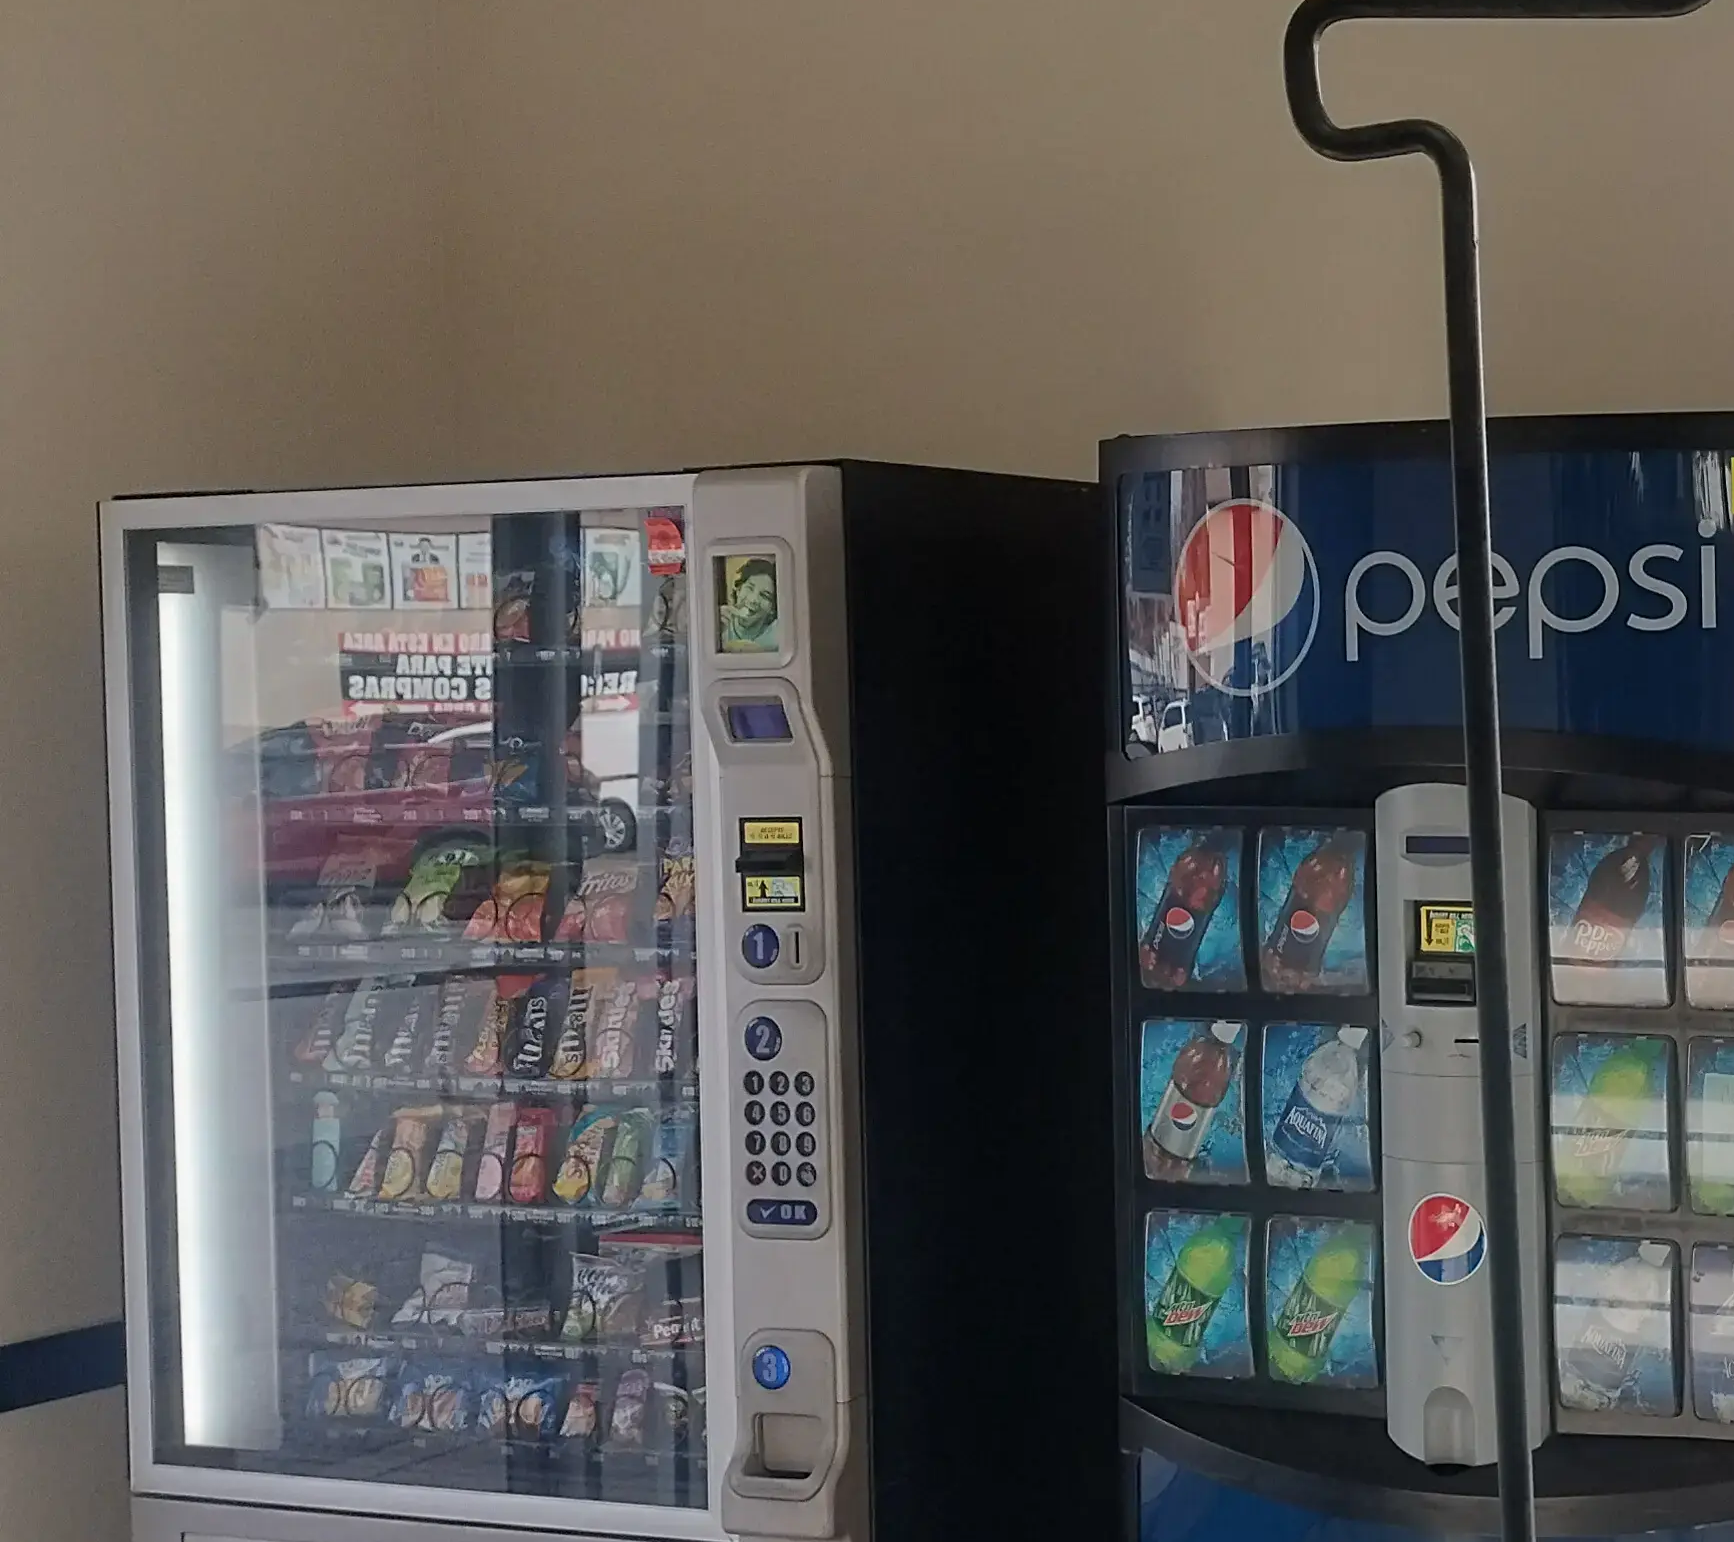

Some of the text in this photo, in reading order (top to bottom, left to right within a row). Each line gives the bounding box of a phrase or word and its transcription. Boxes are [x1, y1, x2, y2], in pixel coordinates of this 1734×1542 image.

[1345, 517, 1717, 661] pepsi
[752, 931, 765, 960] 1
[1592, 924, 1613, 943] Dr
[755, 1025, 771, 1054] 2
[1284, 1105, 1327, 1149] AQUAFINA
[780, 1205, 807, 1220] OK
[762, 1353, 777, 1381] 3
